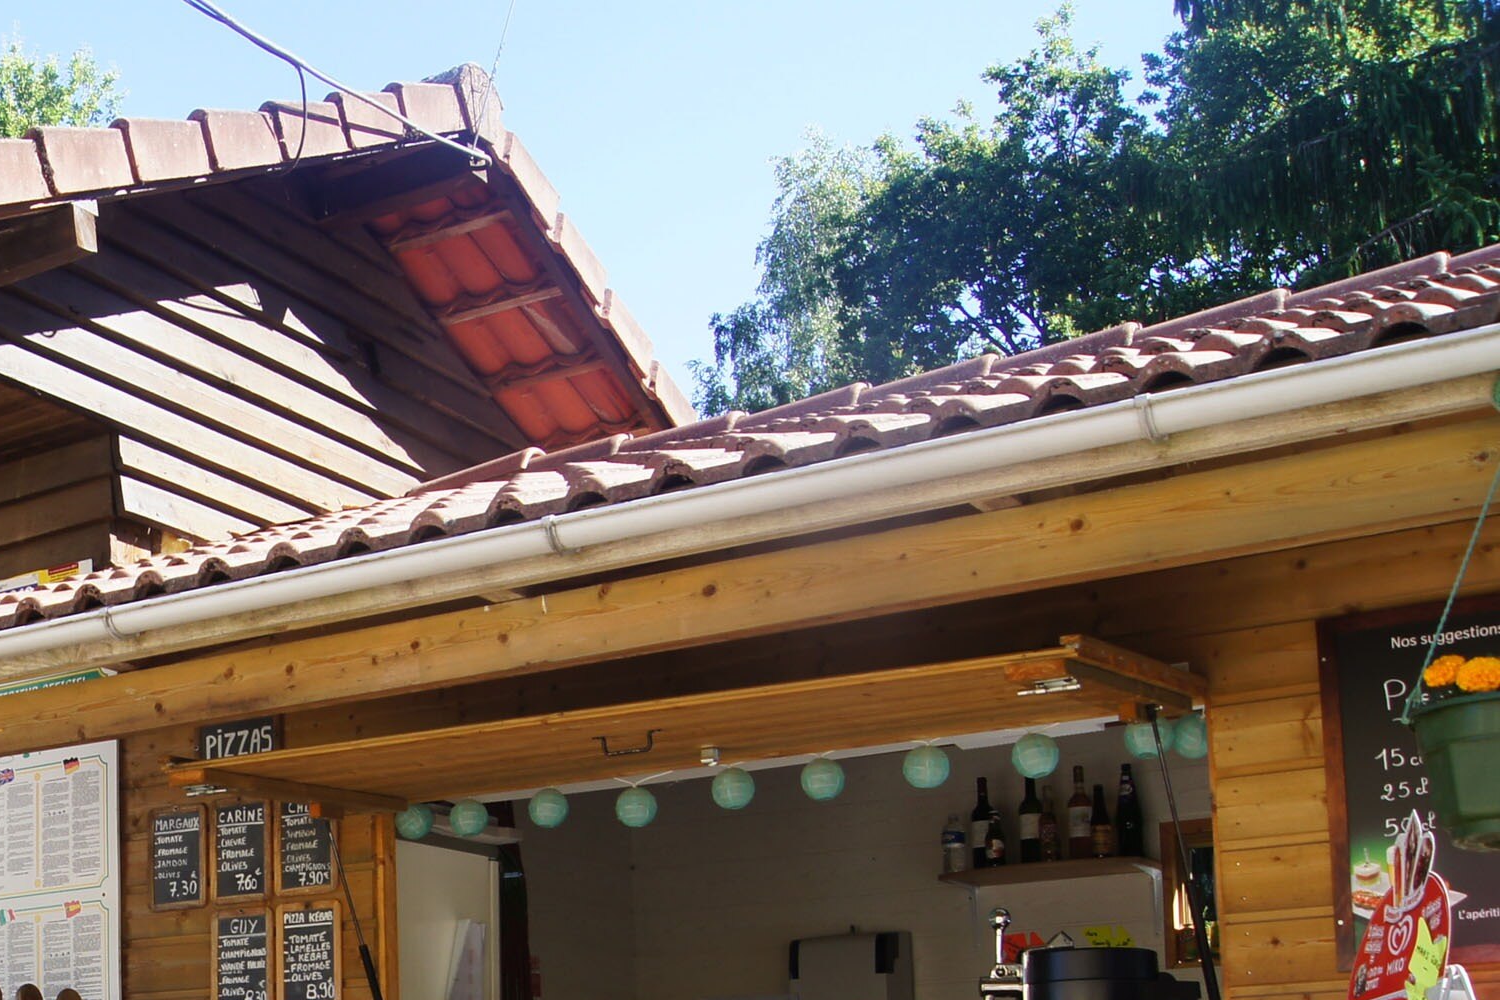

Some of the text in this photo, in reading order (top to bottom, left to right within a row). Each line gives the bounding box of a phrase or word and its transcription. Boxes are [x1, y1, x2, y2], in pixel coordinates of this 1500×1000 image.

[1390, 636, 1418, 649] Nos
[1374, 748, 1405, 771] 15
[1380, 781, 1411, 802] 25
[155, 816, 200, 832] MARGAUX
[220, 826, 247, 836] TOMATE
[221, 848, 255, 859] FROMAGE
[308, 910, 333, 922] KEBAB
[230, 918, 258, 934] GUY
[222, 937, 250, 947] TOMATE
[288, 931, 327, 944] TOMATE
[290, 942, 331, 954] LAMELLES
[298, 951, 328, 962] KEBAB
[290, 960, 331, 972] FROMAGE
[1387, 958, 1405, 977] MIKO
